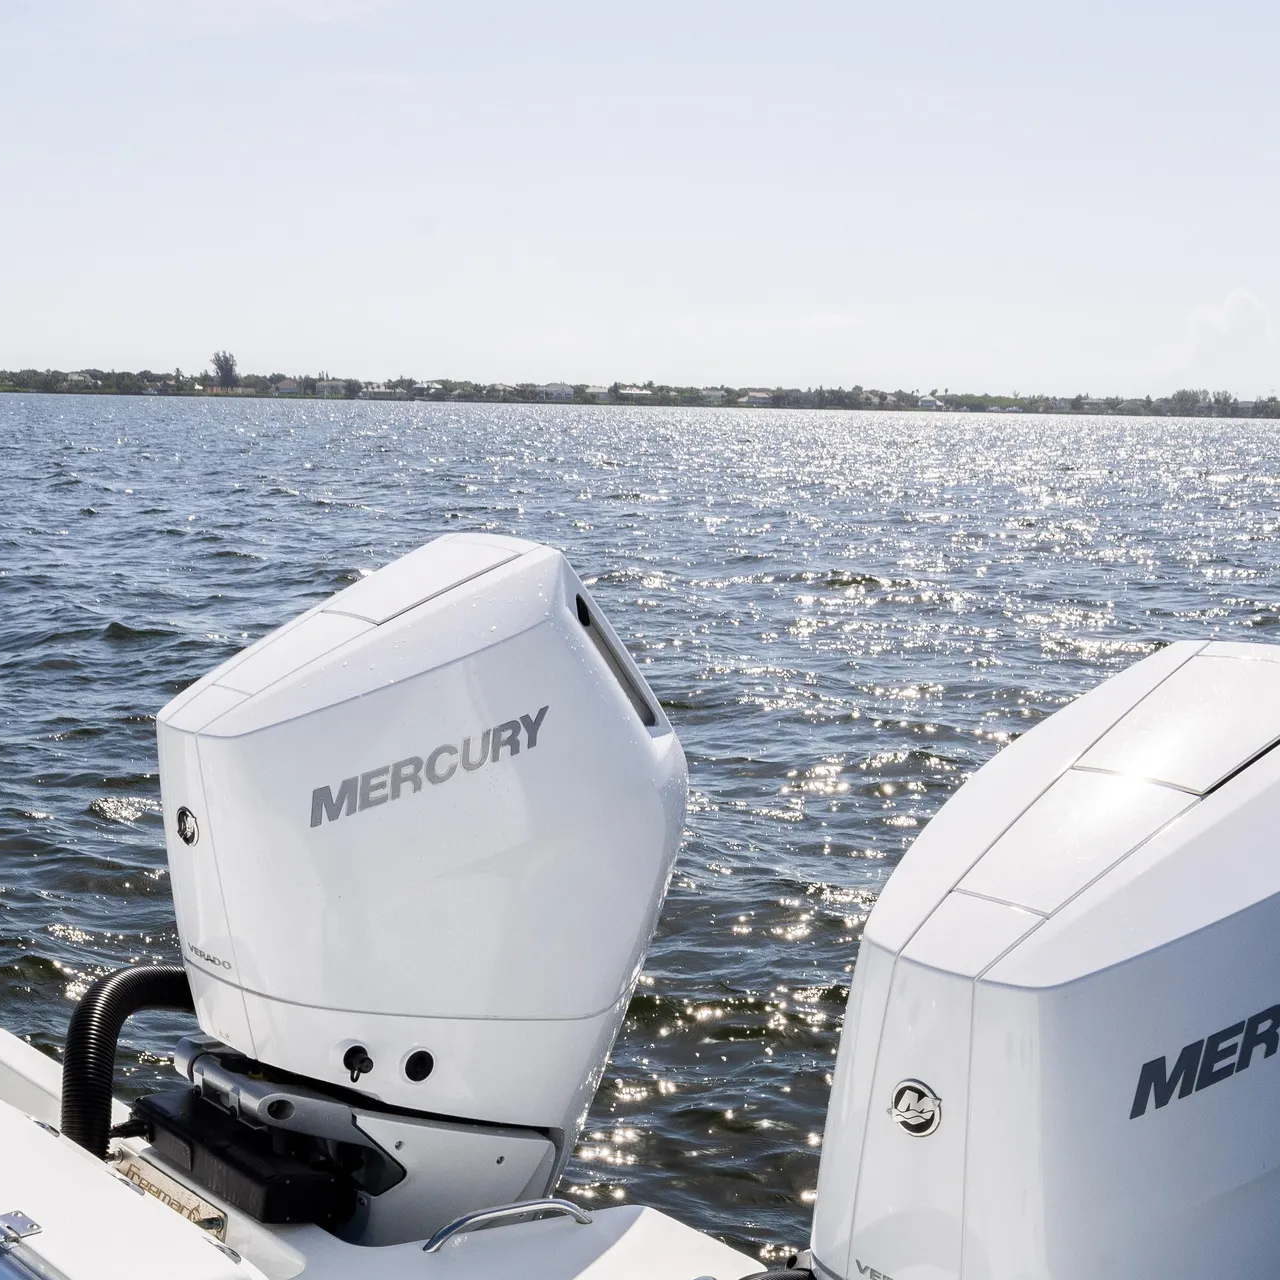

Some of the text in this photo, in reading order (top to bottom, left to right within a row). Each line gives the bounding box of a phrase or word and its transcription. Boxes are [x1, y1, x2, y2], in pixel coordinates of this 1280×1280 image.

[309, 705, 550, 828] MERCURY
[187, 942, 232, 970] VERADO
[125, 1163, 192, 1220] Freeman
